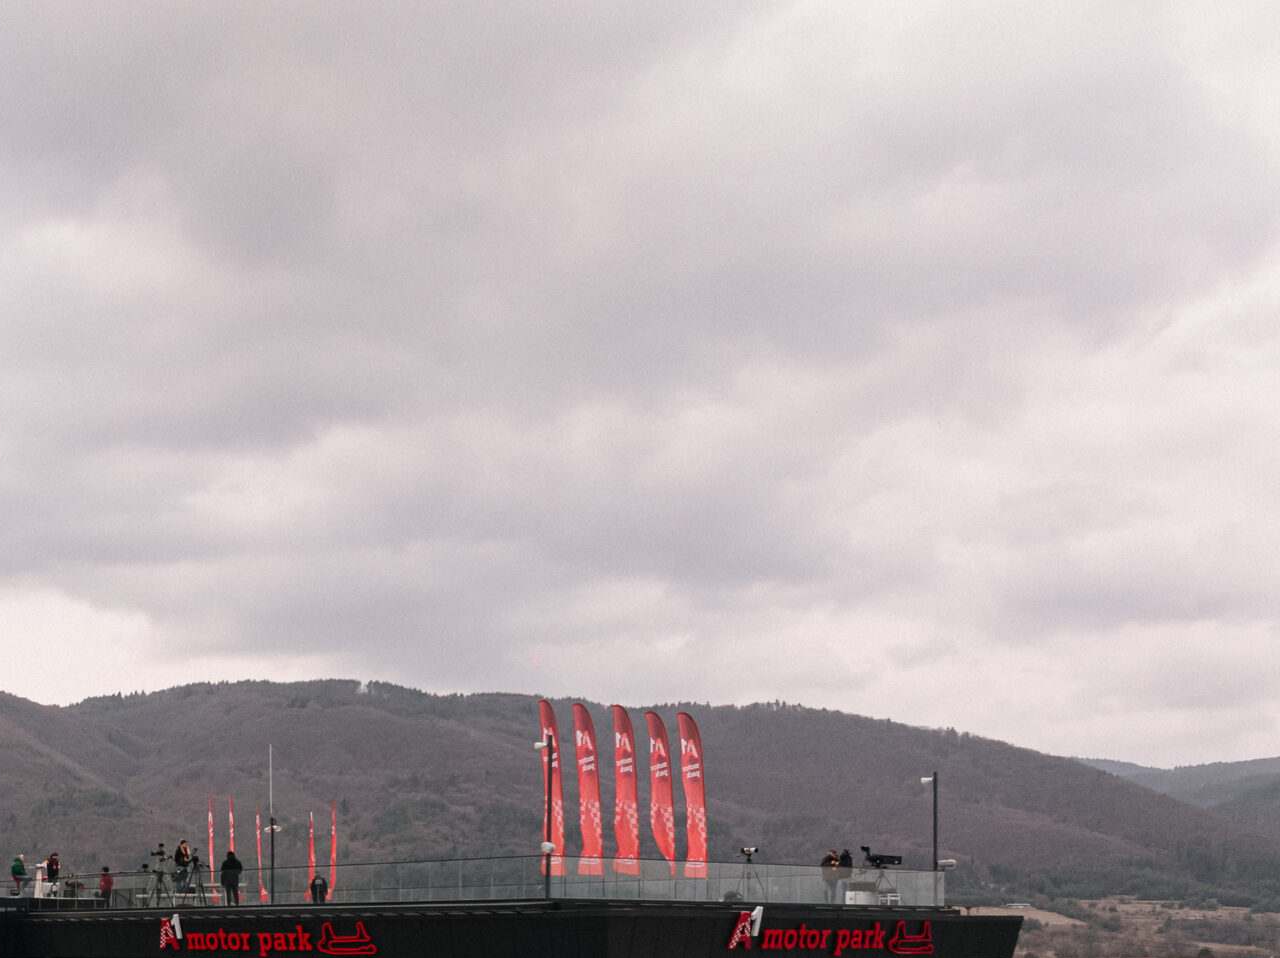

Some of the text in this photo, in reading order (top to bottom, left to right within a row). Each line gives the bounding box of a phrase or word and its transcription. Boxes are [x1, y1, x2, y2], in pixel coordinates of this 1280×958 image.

[160, 913, 313, 957] A1 motor park
[728, 906, 887, 956] A1 motor park
